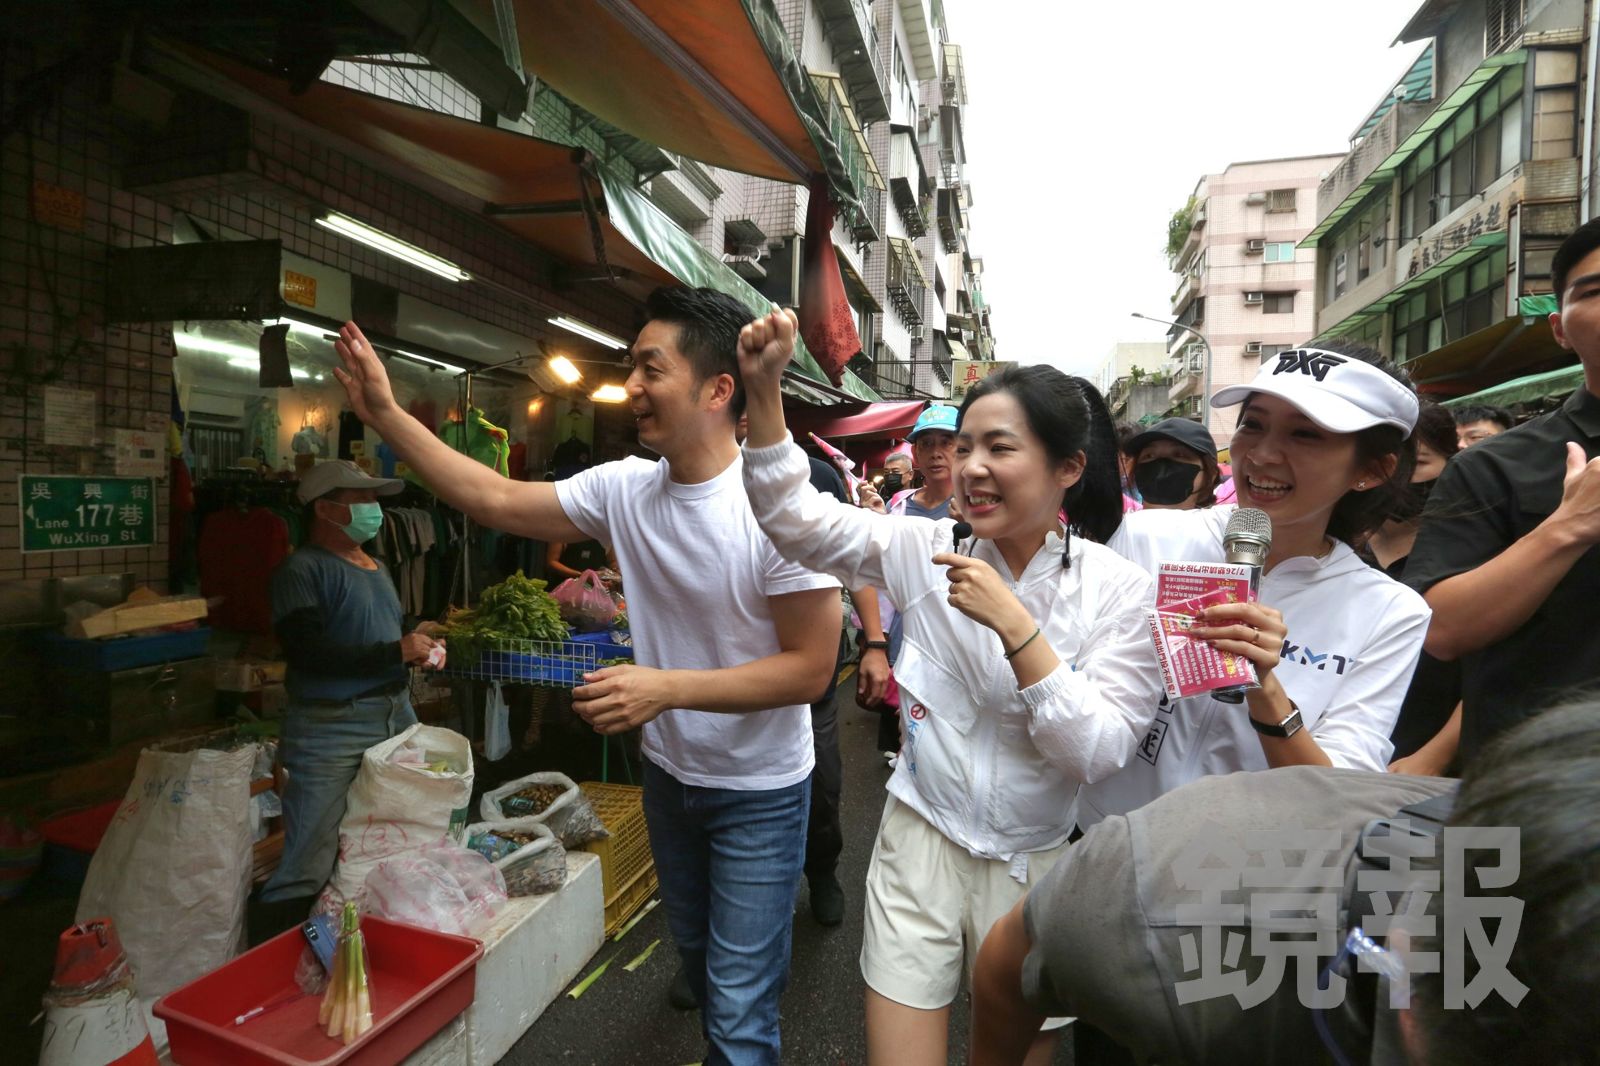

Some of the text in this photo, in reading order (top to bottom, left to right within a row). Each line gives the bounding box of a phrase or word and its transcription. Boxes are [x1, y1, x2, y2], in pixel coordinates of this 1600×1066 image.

[1272, 349, 1349, 382] PXG
[30, 482, 149, 500] 吳興街
[35, 518, 69, 529] Lane
[49, 532, 110, 545] WuXing
